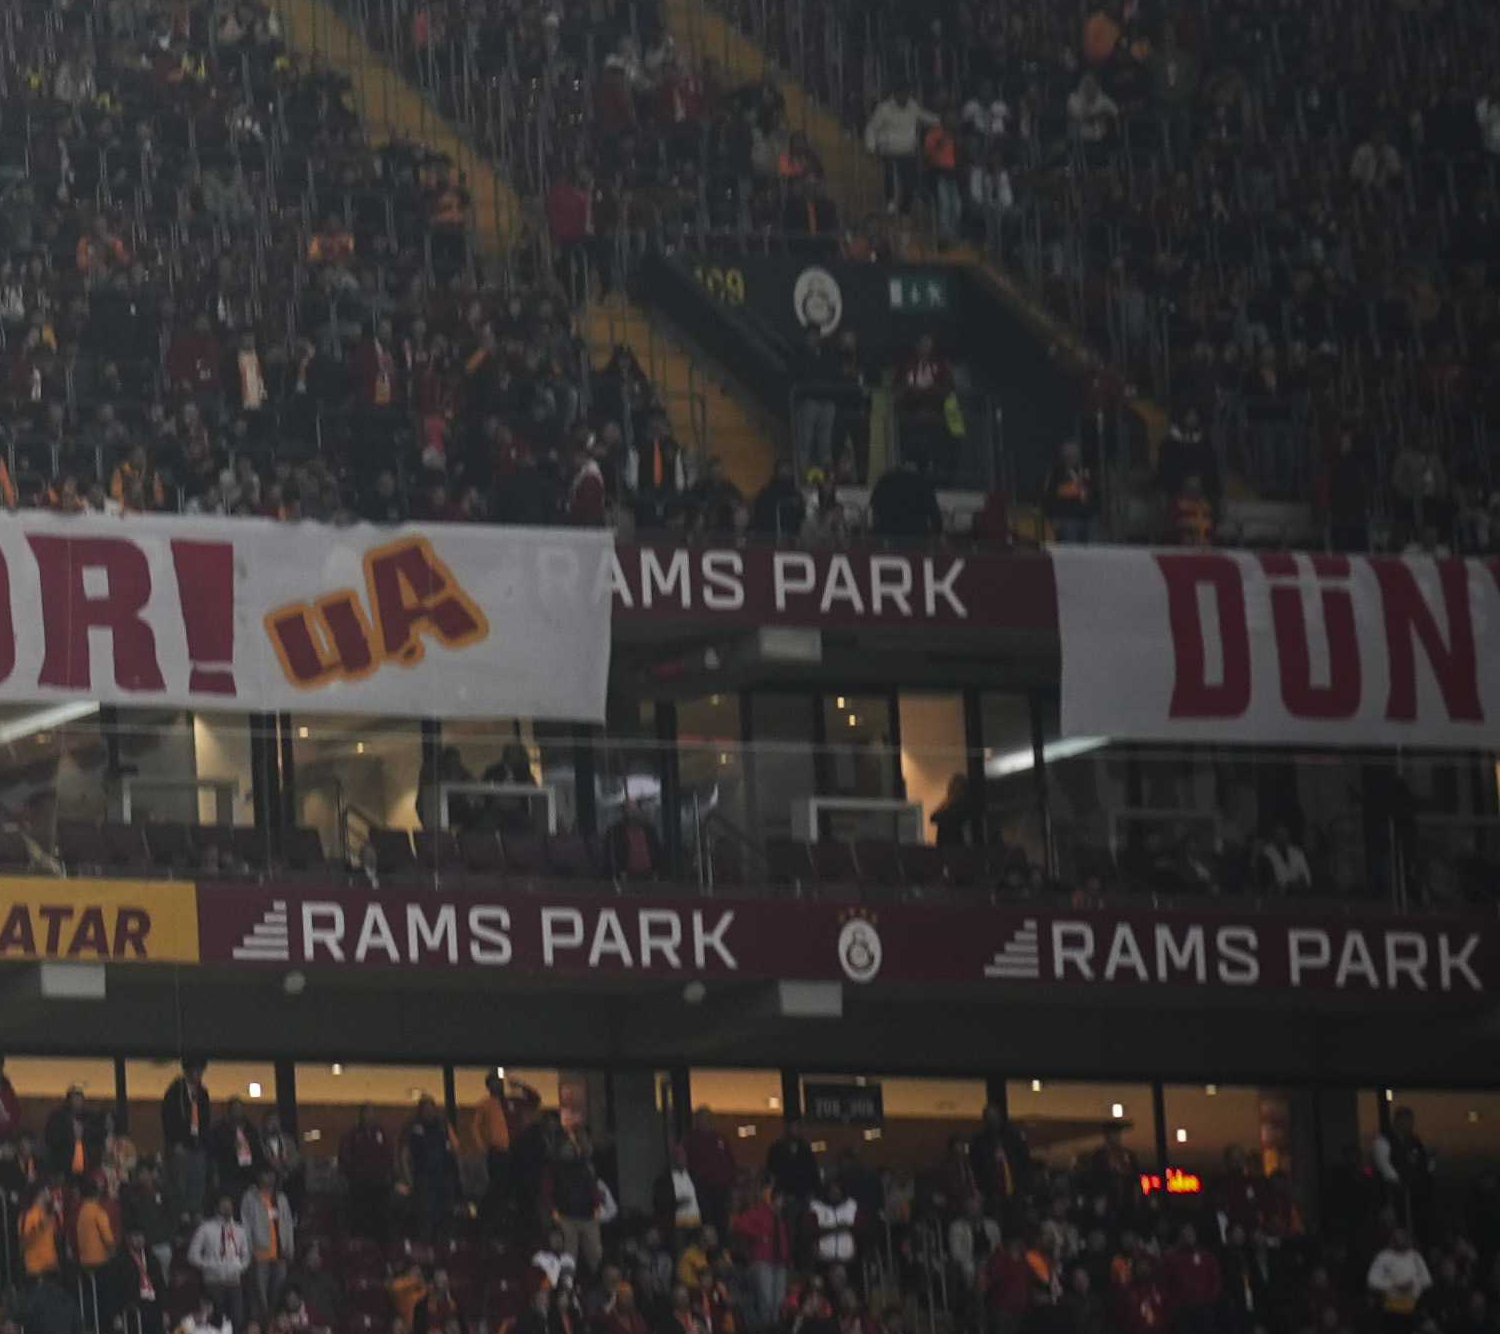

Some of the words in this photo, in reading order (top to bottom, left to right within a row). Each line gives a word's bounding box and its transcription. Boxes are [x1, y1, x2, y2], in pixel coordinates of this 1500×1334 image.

[774, 553, 968, 618] PARK
[1152, 553, 1500, 724] DÜN
[301, 902, 512, 966] RAMS
[539, 908, 738, 969] PARK
[1051, 919, 1259, 985] RAMS
[1288, 929, 1484, 991] PARK
